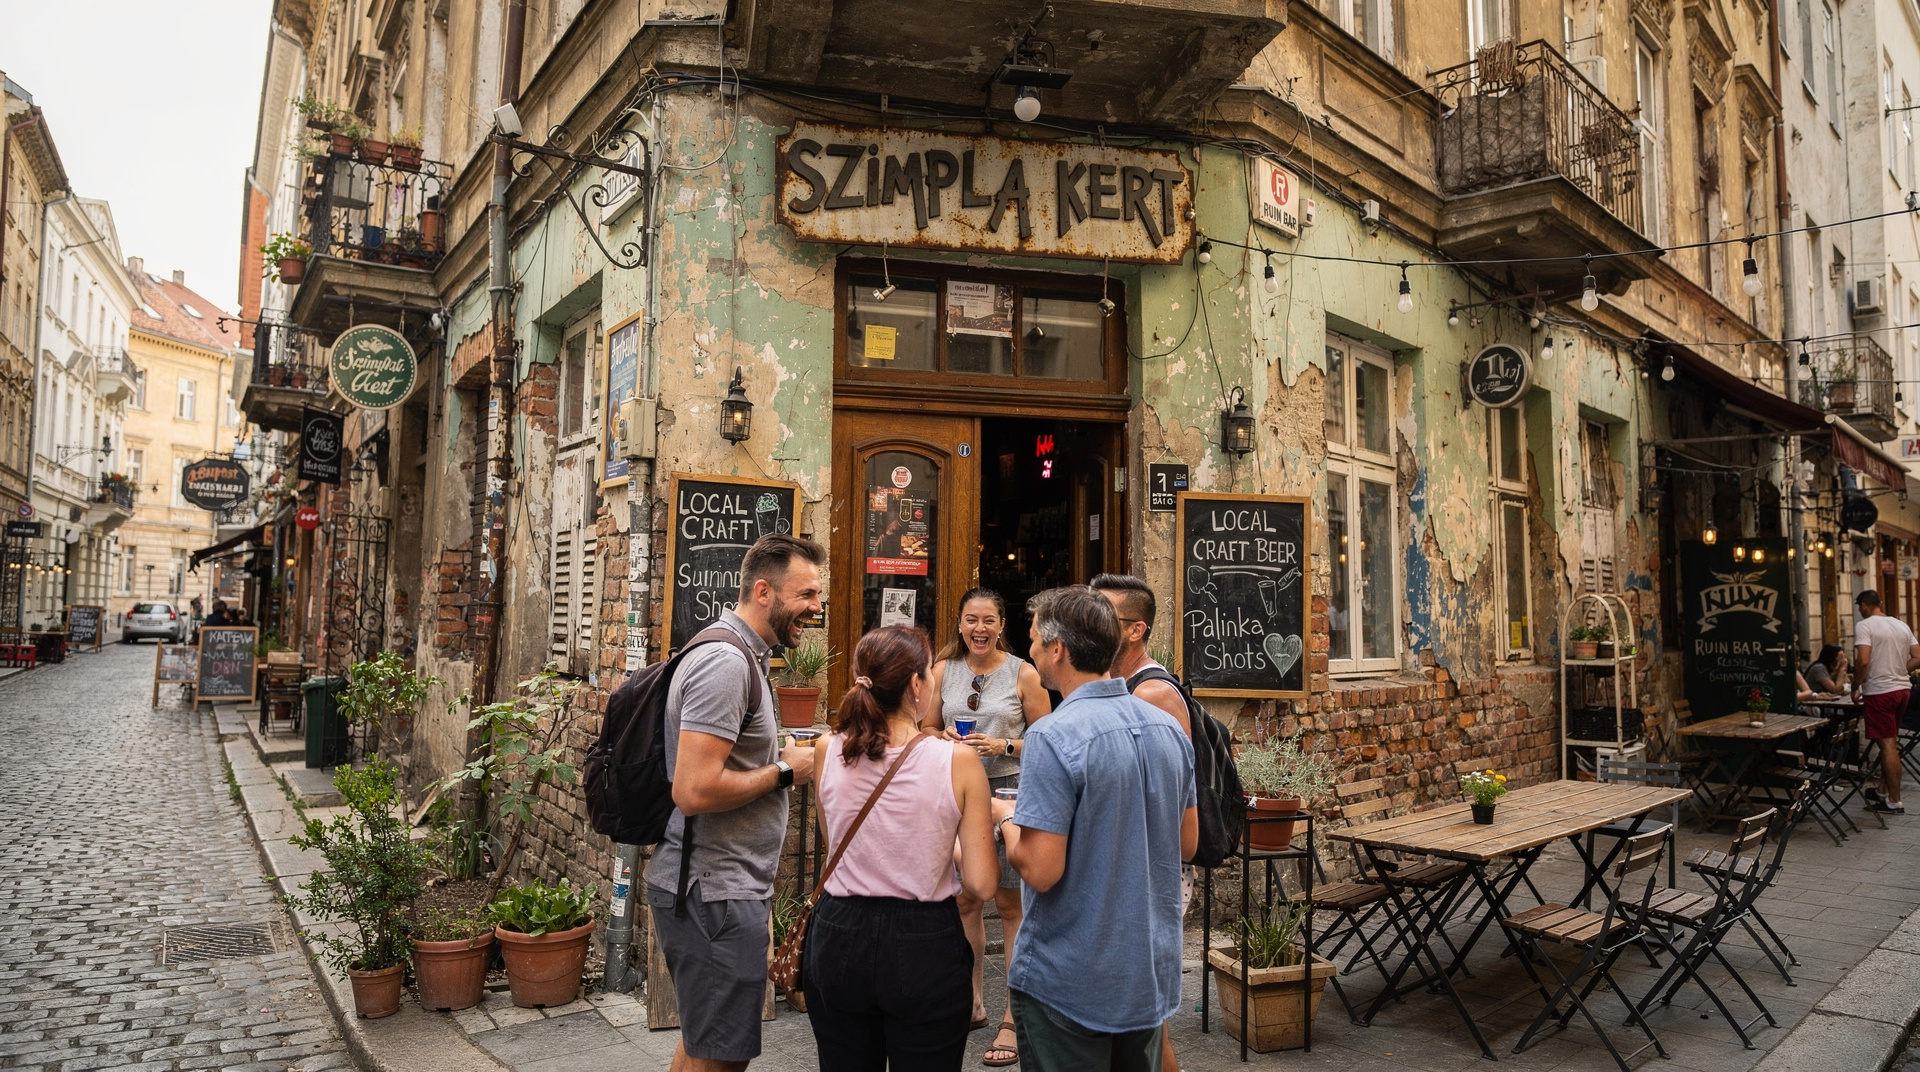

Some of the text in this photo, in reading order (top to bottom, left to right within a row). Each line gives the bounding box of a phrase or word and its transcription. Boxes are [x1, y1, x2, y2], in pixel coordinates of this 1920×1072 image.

[1057, 160, 1185, 249] KERT
[1263, 202, 1282, 224] RUIN
[679, 490, 748, 516] LOCAL
[681, 515, 754, 541] CRAFT
[1211, 509, 1277, 532] LOCAL
[1193, 537, 1298, 565] CRAFT BEER
[1183, 606, 1265, 641] Palinka
[1203, 642, 1267, 671] Shots
[1694, 638, 1765, 656] RUIN BAR
